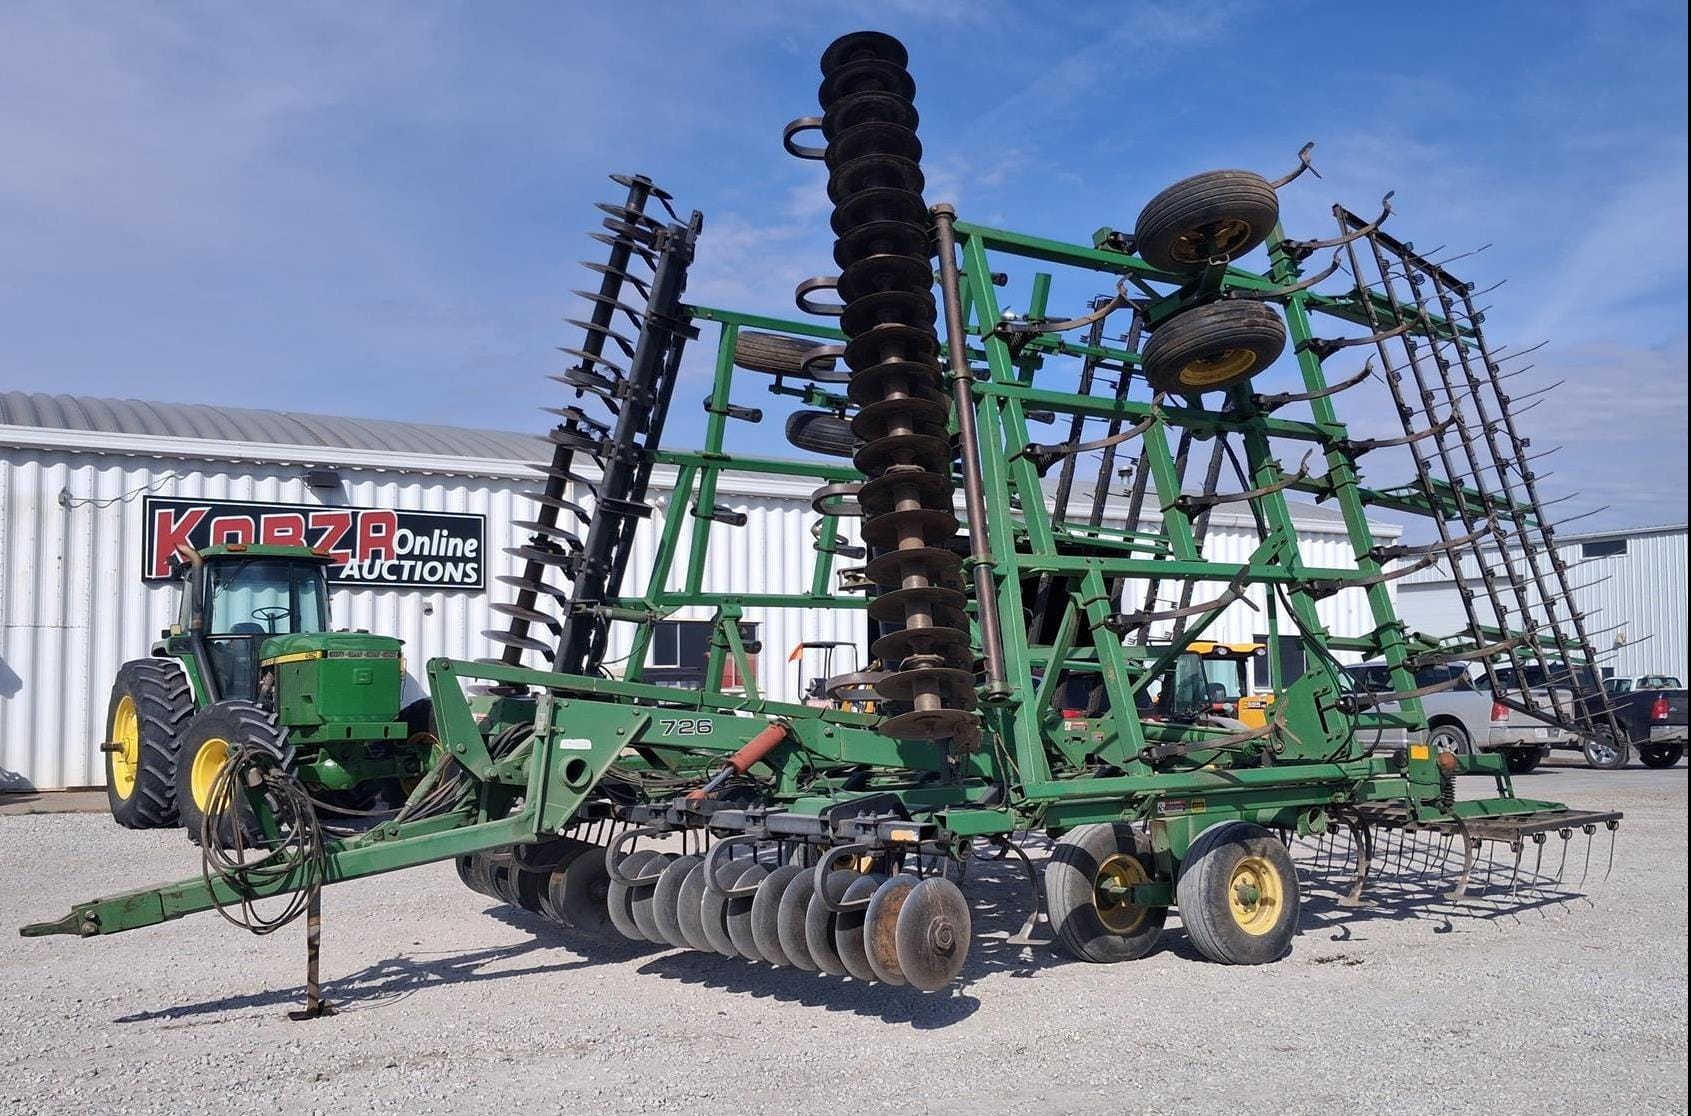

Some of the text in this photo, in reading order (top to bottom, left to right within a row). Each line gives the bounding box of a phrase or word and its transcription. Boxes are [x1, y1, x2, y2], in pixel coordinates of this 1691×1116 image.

[392, 528, 478, 558] Online
[339, 558, 479, 584] AUCTIONS
[660, 718, 714, 737] 726
